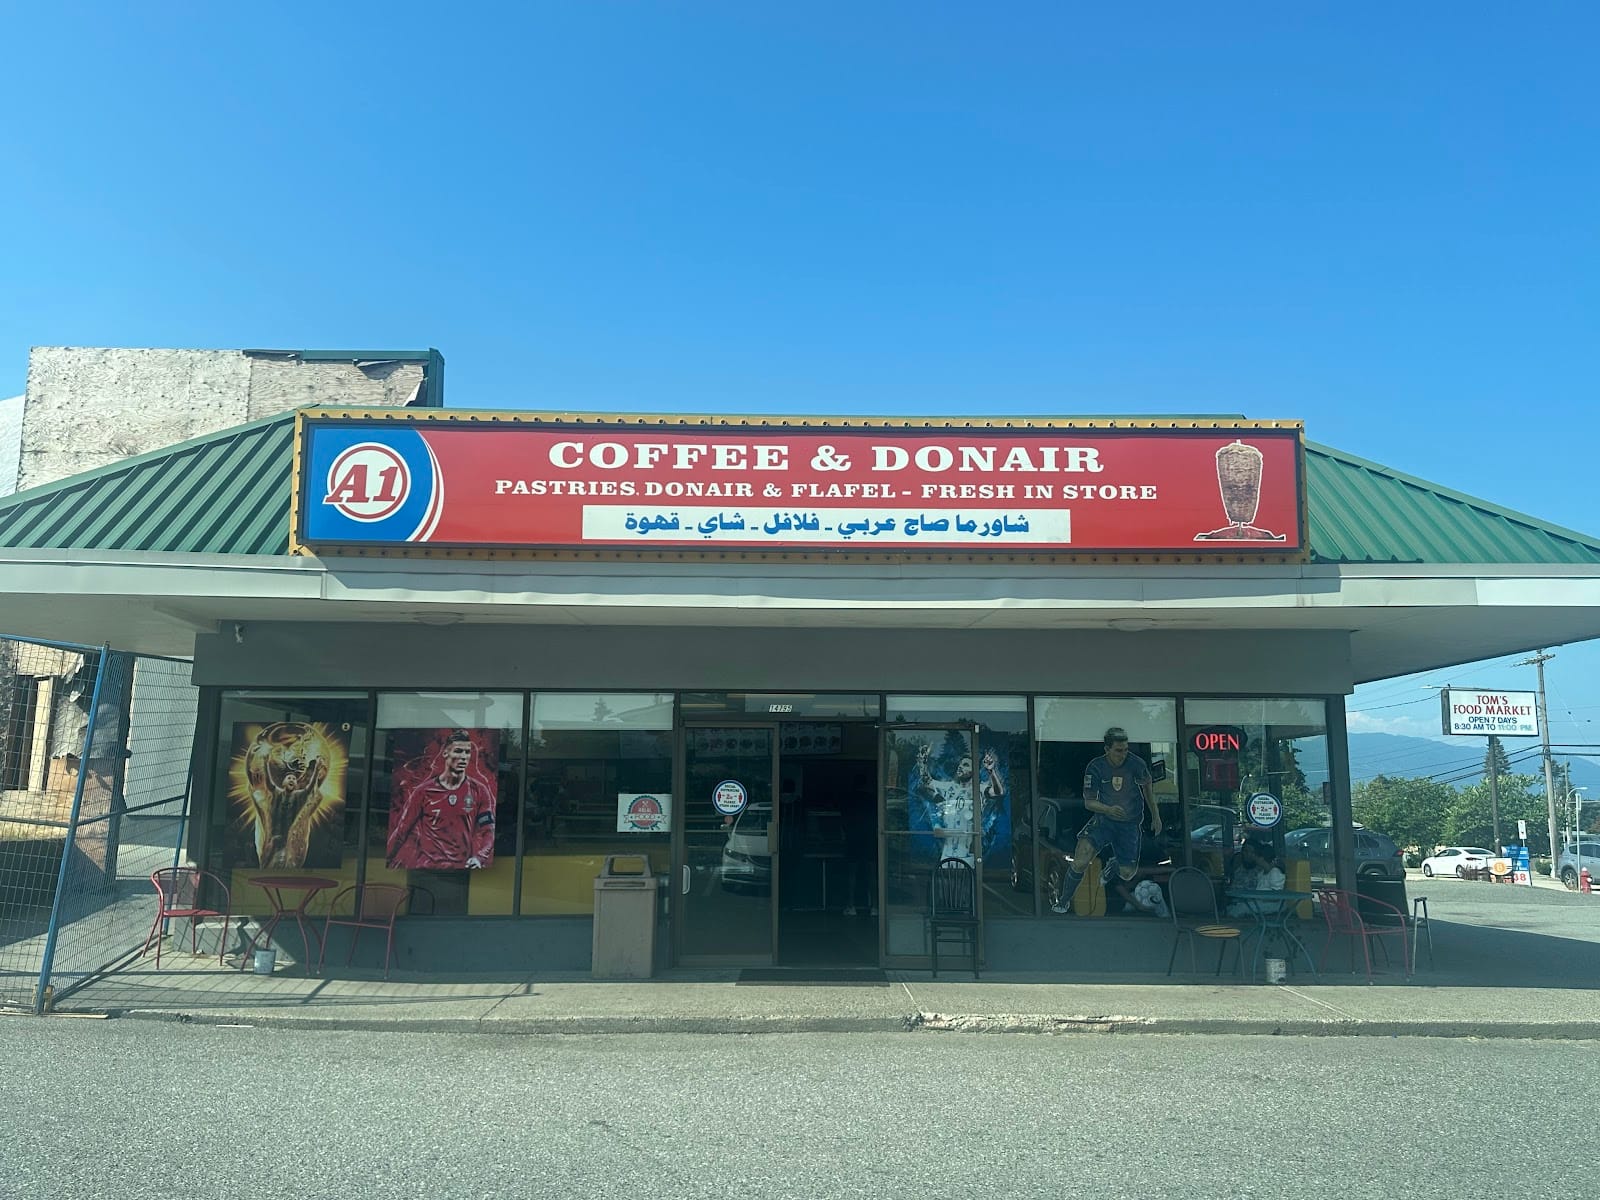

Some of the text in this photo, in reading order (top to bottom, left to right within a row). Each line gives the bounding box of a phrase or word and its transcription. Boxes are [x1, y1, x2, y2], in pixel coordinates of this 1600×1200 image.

[548, 441, 1105, 474] COFFEE & DONAIR
[324, 464, 399, 503] A1
[644, 481, 755, 498] DONAIR
[762, 482, 783, 498] &
[790, 483, 897, 499] FLAFEL
[920, 484, 1016, 500] FRESH
[1023, 484, 1054, 500] IN
[1062, 484, 1157, 501] STORE
[624, 512, 680, 535] قهوة
[697, 512, 745, 539] شاي
[763, 512, 820, 535] فلافل
[838, 517, 896, 540] عربي
[903, 514, 950, 536] صاج
[956, 514, 1030, 536] شاورما
[1453, 704, 1532, 716] FOOD MARKET
[1477, 694, 1508, 705] TOM'S
[1468, 716, 1490, 724] OPEN
[1497, 717, 1518, 725] DAYS
[1195, 732, 1240, 751] OPEN
[431, 808, 441, 826] 7
